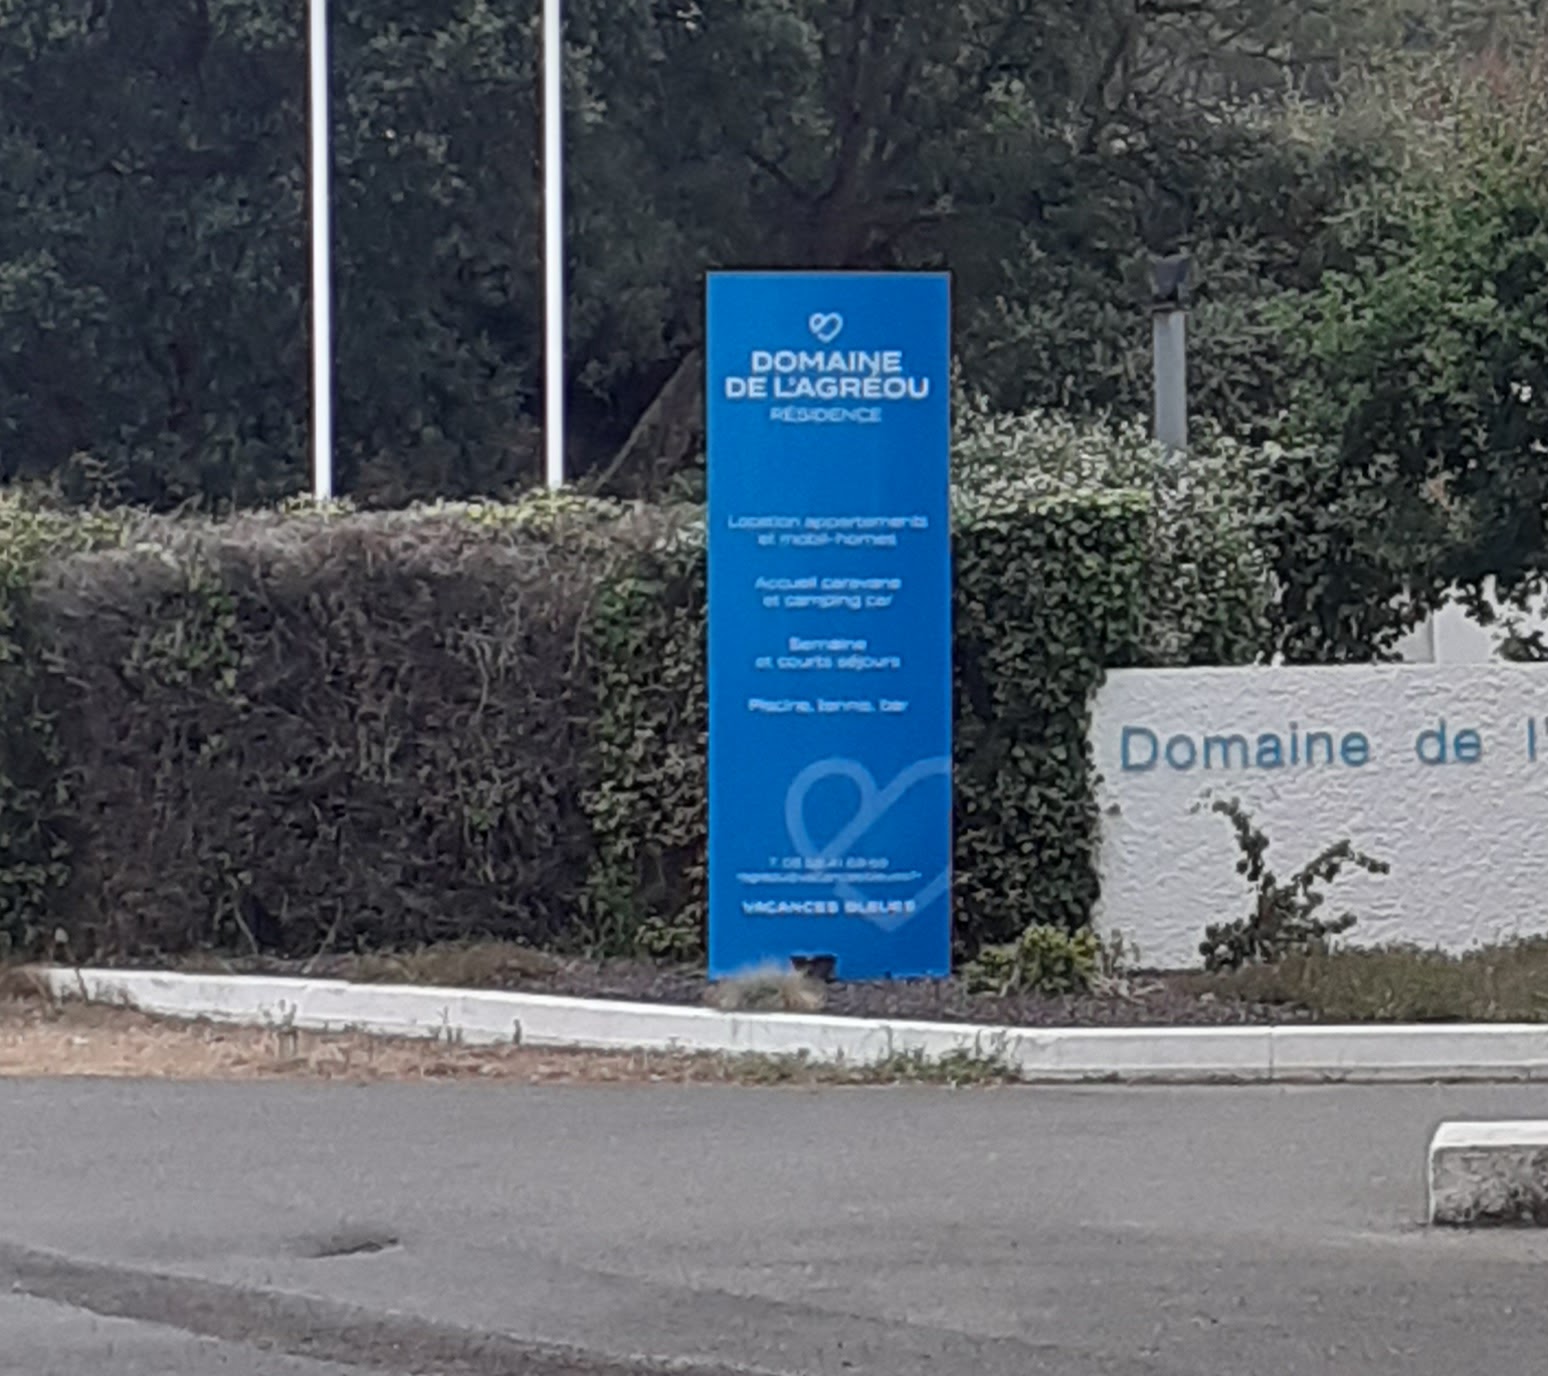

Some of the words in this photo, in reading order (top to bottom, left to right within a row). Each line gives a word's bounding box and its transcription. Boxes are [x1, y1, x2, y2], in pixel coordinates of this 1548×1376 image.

[751, 350, 903, 373] DOMAINE
[725, 376, 768, 399] DE
[769, 405, 882, 423] RÉSIDENCE
[727, 514, 801, 529] Location
[804, 514, 929, 530] appartements
[757, 532, 776, 546] et
[754, 576, 818, 590] Accueil
[762, 594, 780, 608] et
[784, 594, 862, 609] camping
[755, 655, 773, 669] et
[1119, 721, 1371, 772] Domaine
[1415, 718, 1484, 766] de
[741, 900, 839, 915] VACANCES
